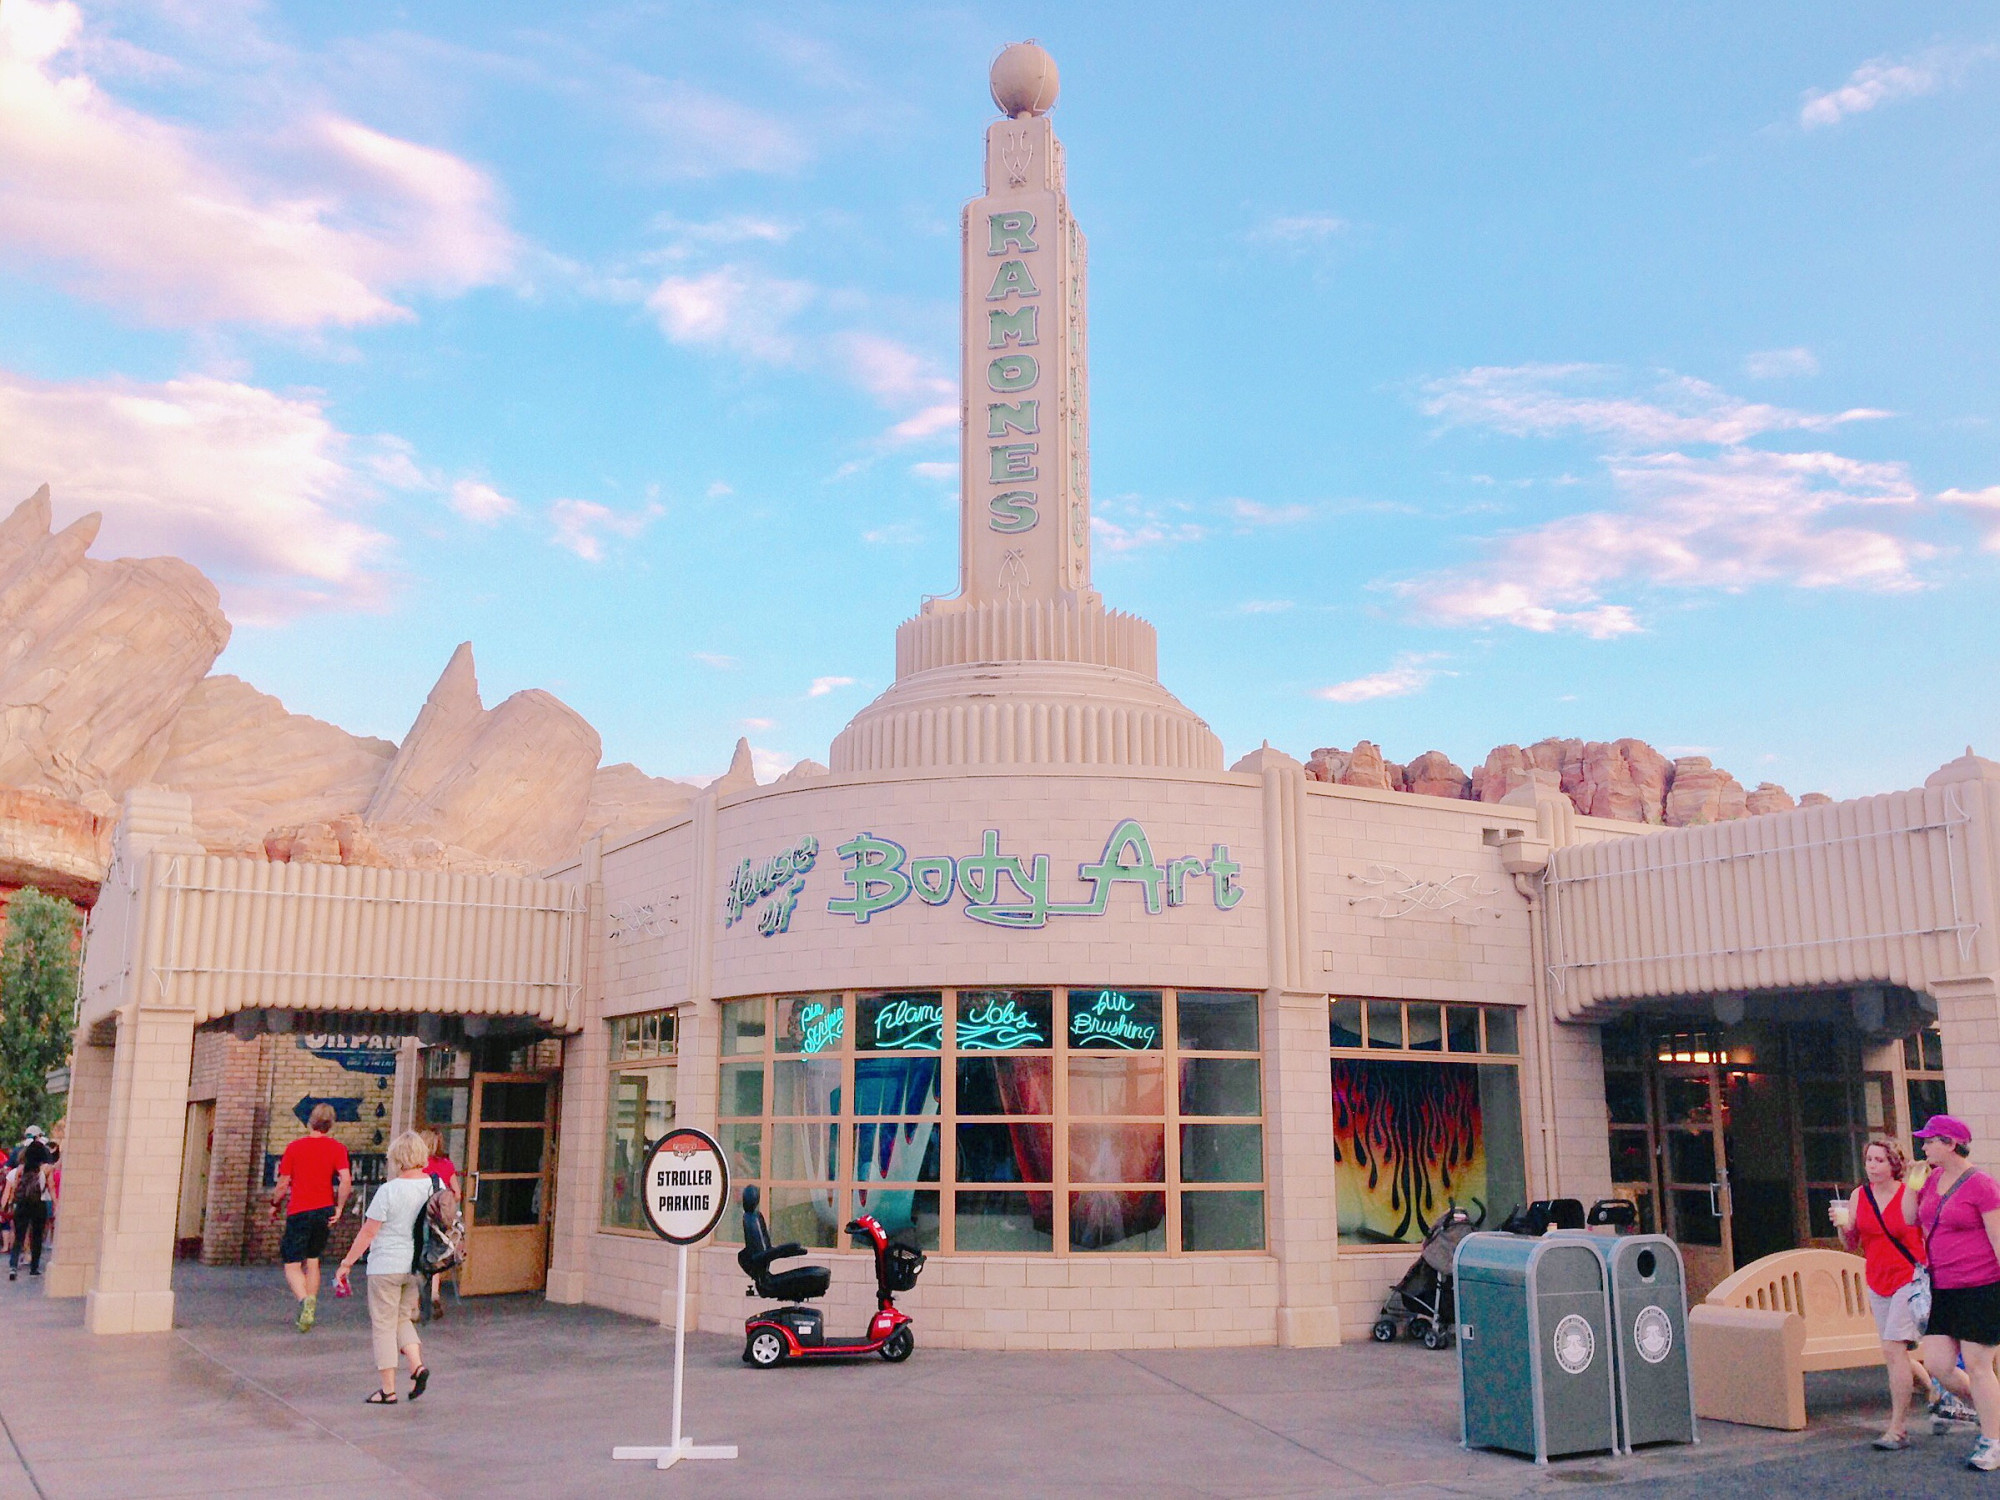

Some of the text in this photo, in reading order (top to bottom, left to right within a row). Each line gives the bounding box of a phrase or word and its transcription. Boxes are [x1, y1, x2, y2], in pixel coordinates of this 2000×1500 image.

[986, 209, 1041, 534] RAMONES
[725, 834, 820, 929] House
[827, 817, 1246, 930] Body Art
[755, 877, 806, 938] of
[801, 1003, 825, 1032] Pin
[969, 1000, 1037, 1029] Jobs
[1092, 990, 1135, 1016] Air
[1070, 1013, 1155, 1050] Brushing
[657, 1169, 712, 1187] STROLLER
[658, 1194, 710, 1212] PARKING
